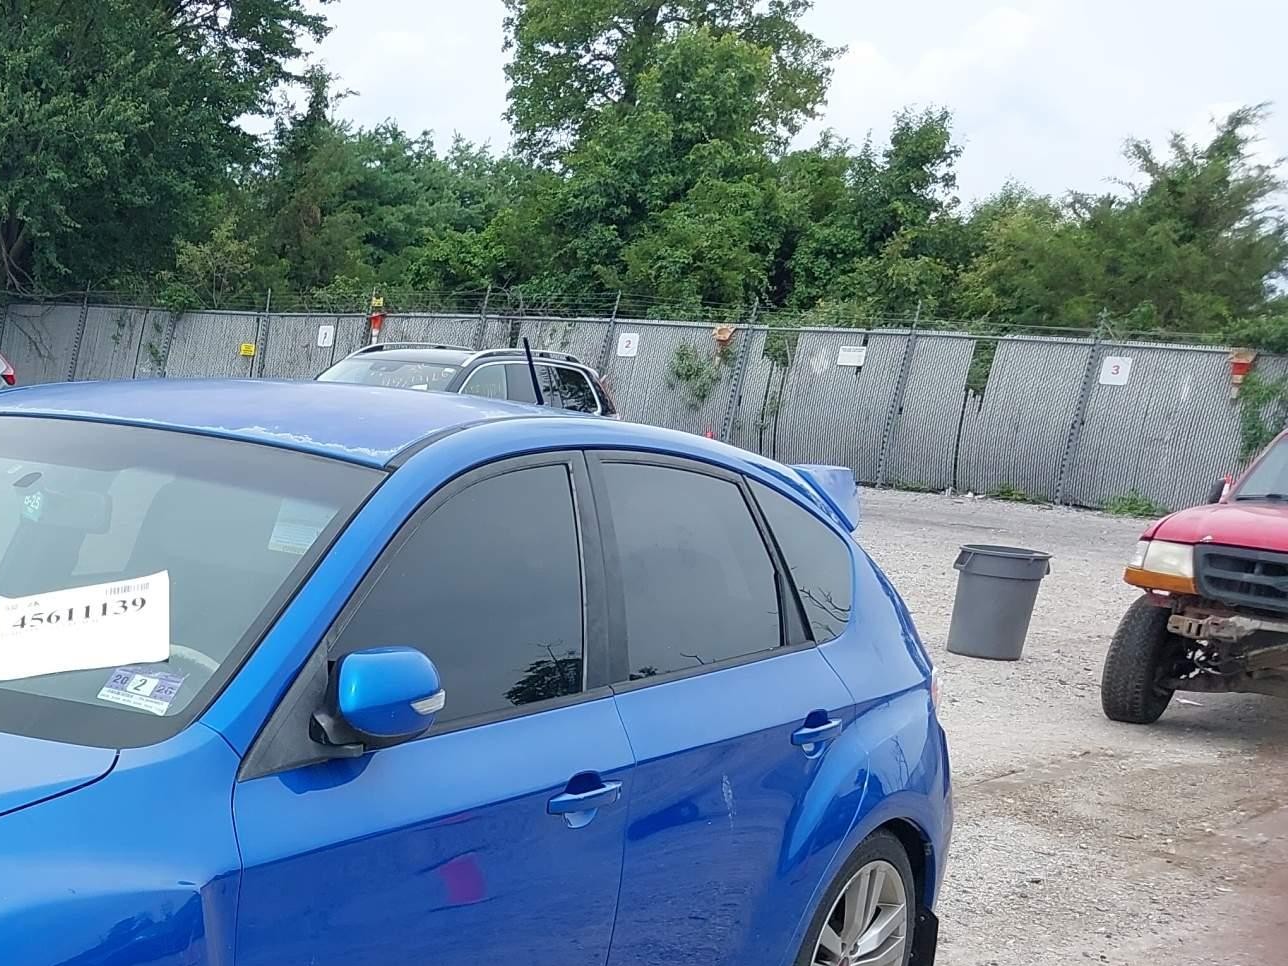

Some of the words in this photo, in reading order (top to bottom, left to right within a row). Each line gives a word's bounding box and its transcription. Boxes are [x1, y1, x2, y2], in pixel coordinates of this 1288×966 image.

[624, 340, 632, 348] 2
[1111, 365, 1120, 375] 3
[12, 597, 147, 629] 45611139
[112, 674, 129, 686] 20
[133, 678, 148, 692] 2
